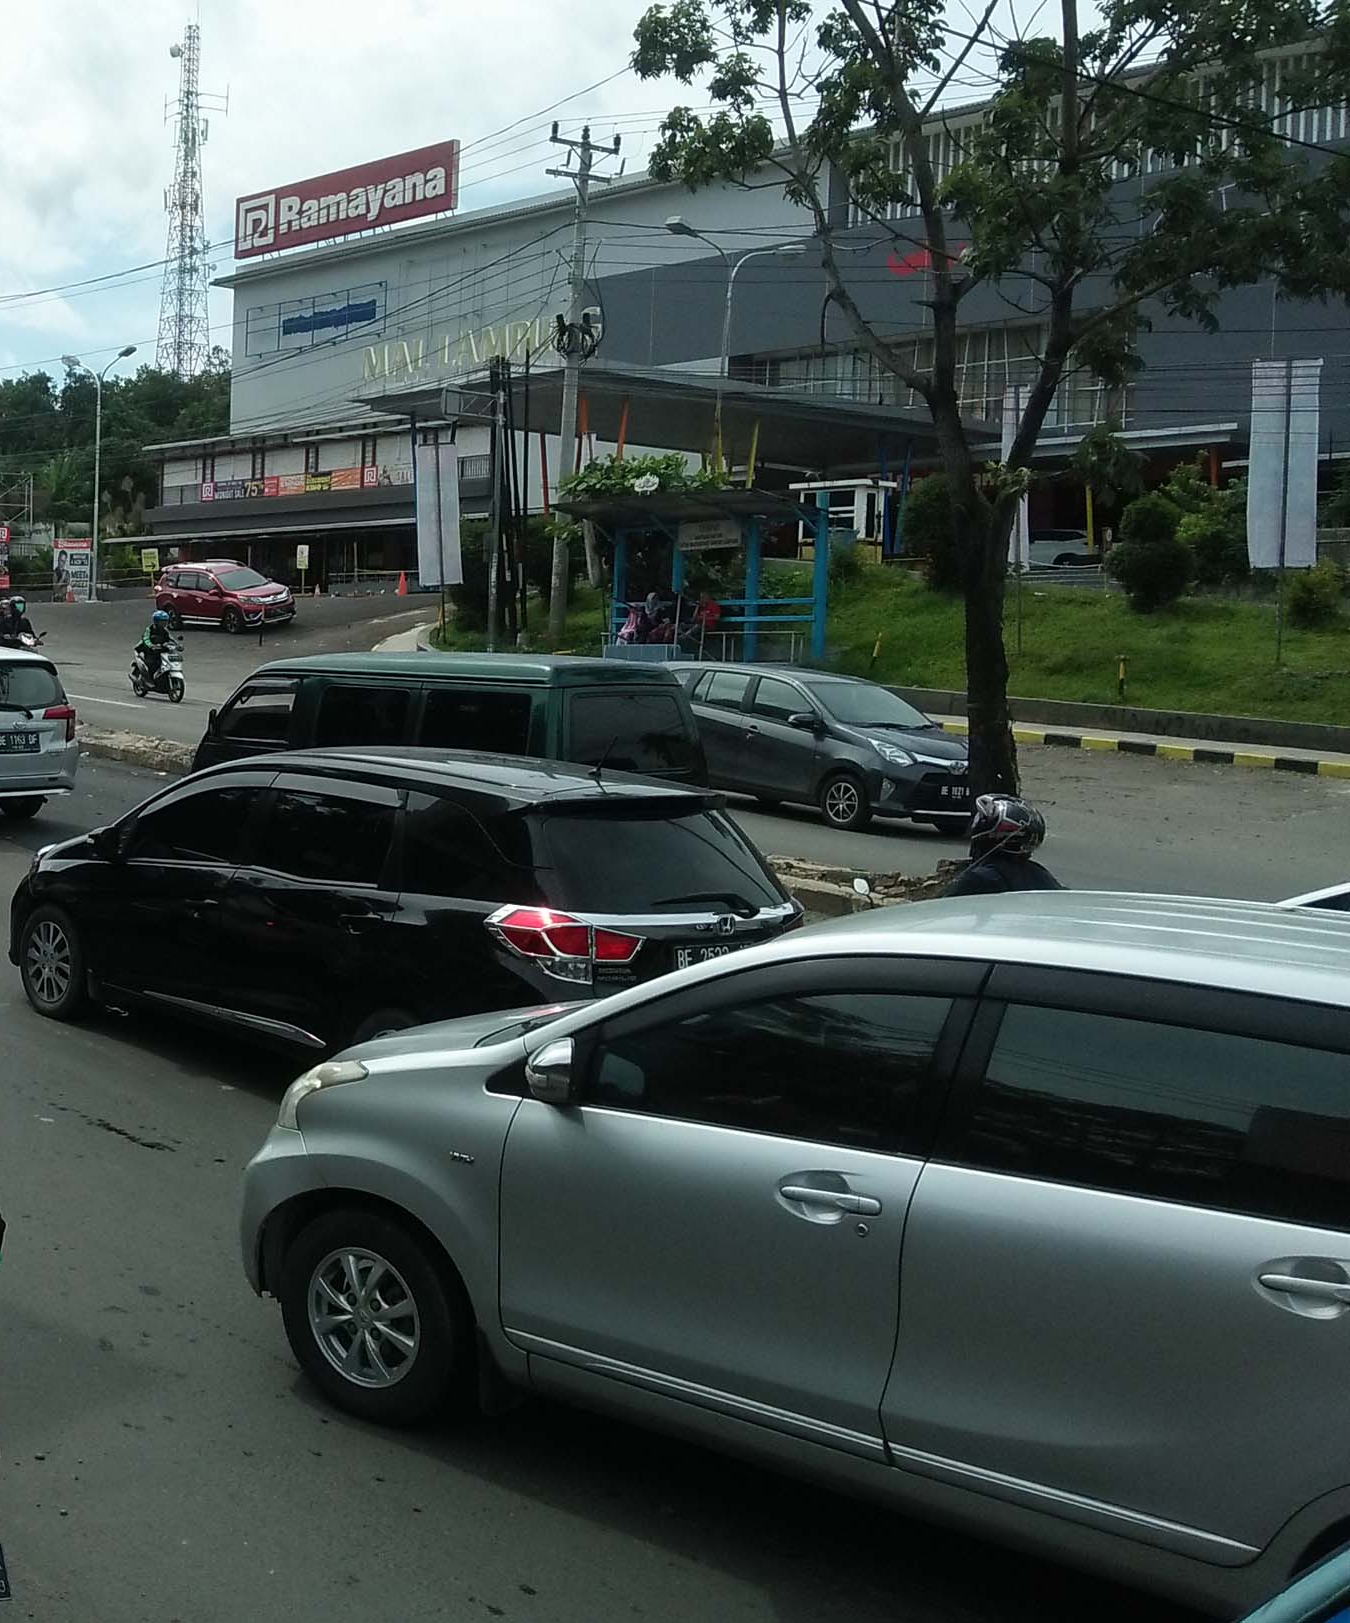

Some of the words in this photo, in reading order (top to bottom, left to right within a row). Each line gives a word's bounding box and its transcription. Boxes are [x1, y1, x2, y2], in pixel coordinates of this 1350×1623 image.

[279, 166, 447, 234] Ramayana
[362, 338, 430, 380] MAL
[677, 949, 693, 968] BE
